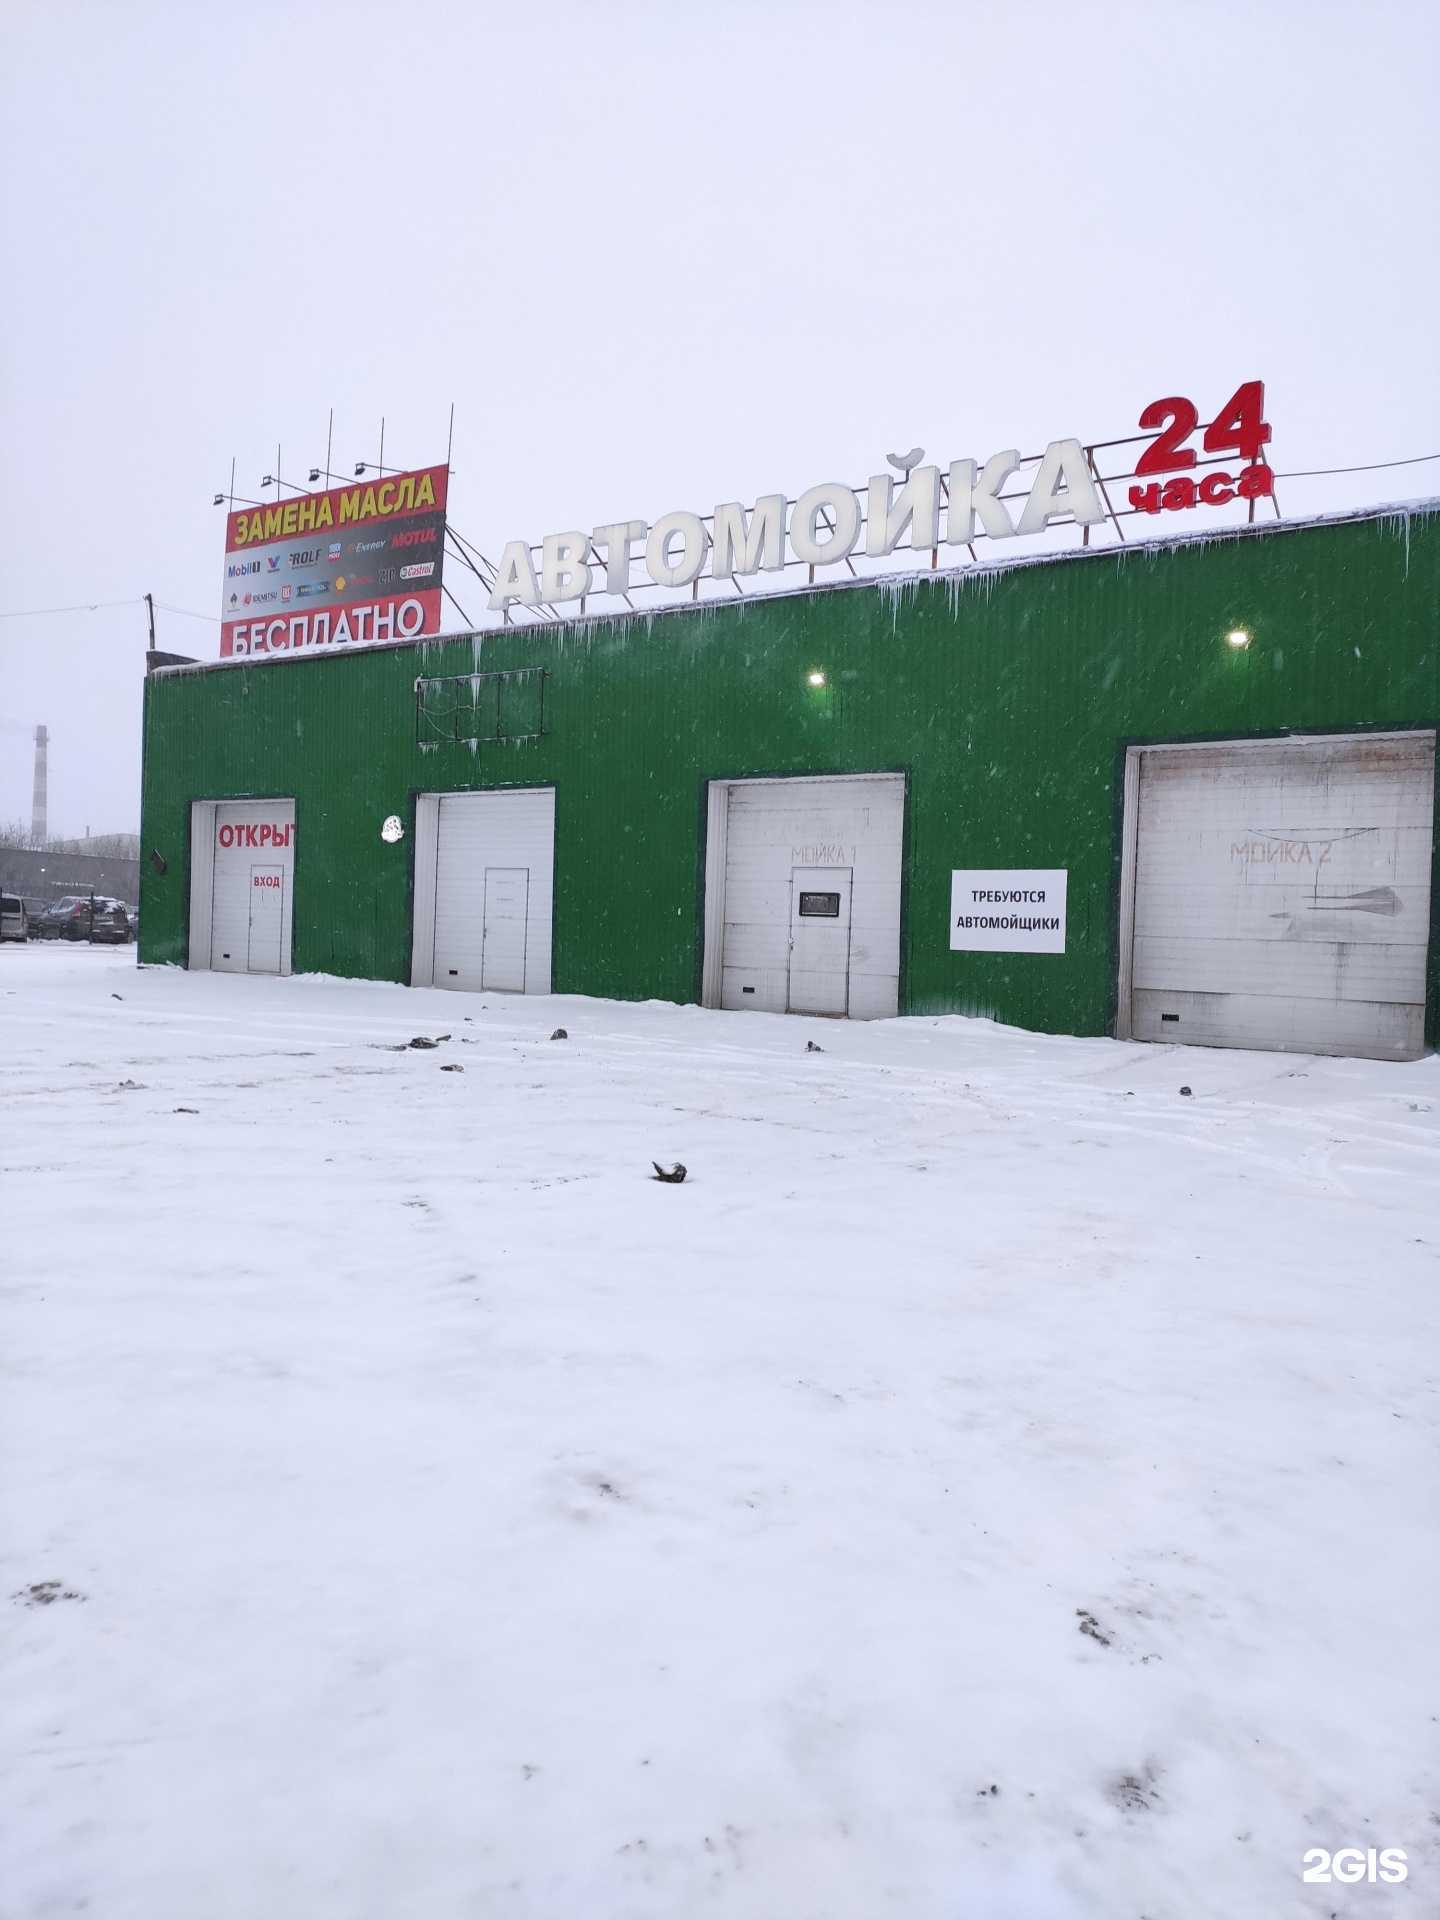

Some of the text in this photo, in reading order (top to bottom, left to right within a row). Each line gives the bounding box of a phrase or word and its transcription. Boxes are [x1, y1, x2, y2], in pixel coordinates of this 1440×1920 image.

[1135, 380, 1272, 477] 24
[1128, 464, 1274, 514] часа
[234, 473, 437, 545] ЗАМЕНА МАСЛА
[487, 439, 1107, 612] АВТОМОЙКА
[391, 528, 437, 548] MOTUL
[293, 549, 322, 565] ROLF
[407, 563, 433, 577] Castrol
[232, 598, 425, 656] БЕСПЛАТНО
[253, 876, 280, 888] ВХОД
[971, 890, 1046, 904] ТРЕБУЮТСЯ
[956, 913, 1061, 932] АВТОМОЙЩИКИ
